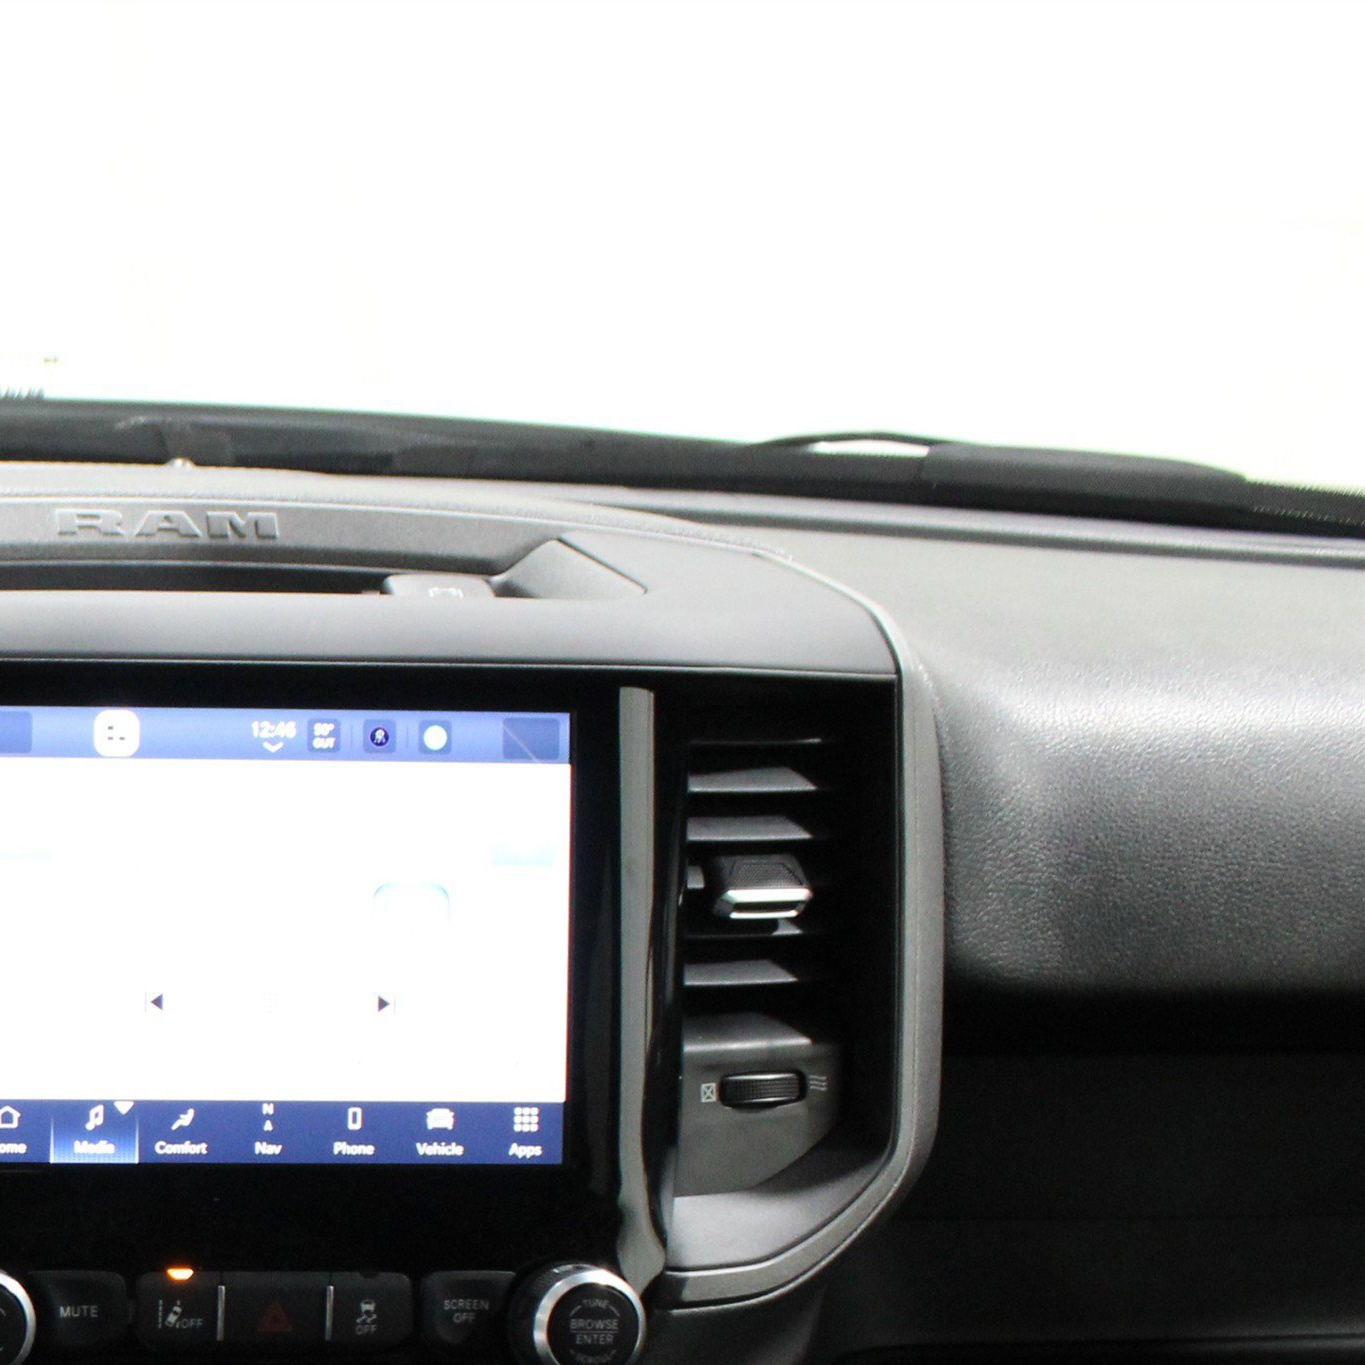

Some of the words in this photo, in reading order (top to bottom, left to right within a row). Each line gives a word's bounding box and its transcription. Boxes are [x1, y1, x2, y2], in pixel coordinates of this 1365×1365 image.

[56, 508, 278, 539] RAM
[154, 1140, 208, 1155] Comfort
[254, 1141, 282, 1156] Nav
[333, 1142, 375, 1156] Phone
[416, 1142, 465, 1157] Vehicle
[508, 1143, 543, 1159] Apps
[59, 1305, 99, 1319] MUTE
[443, 1299, 490, 1312] SCREEN
[180, 1318, 204, 1330] OFF
[452, 1312, 476, 1324] OFF
[570, 1318, 619, 1331] BROWSE
[354, 1324, 377, 1336] OFF
[575, 1334, 614, 1346] ENTER
